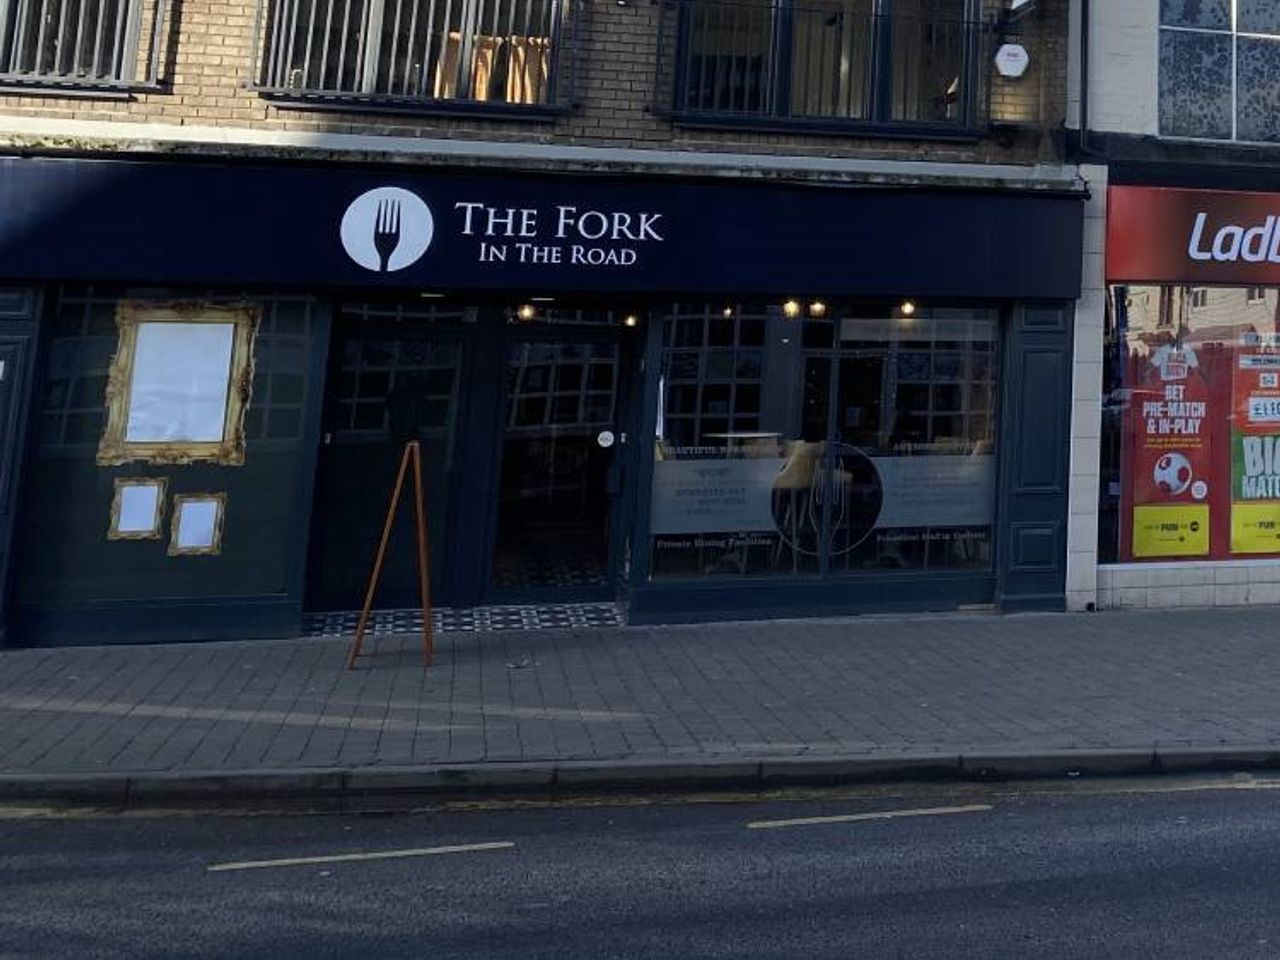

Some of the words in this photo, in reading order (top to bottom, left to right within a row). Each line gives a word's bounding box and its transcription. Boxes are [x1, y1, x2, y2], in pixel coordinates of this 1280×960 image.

[455, 202, 538, 237] THE
[556, 205, 664, 242] FORK
[478, 242, 508, 262] IN
[515, 243, 562, 264] THE
[571, 245, 637, 266] ROAD
[1143, 401, 1206, 418] PRE-MATCH
[1158, 418, 1201, 434] IN-PLAY
